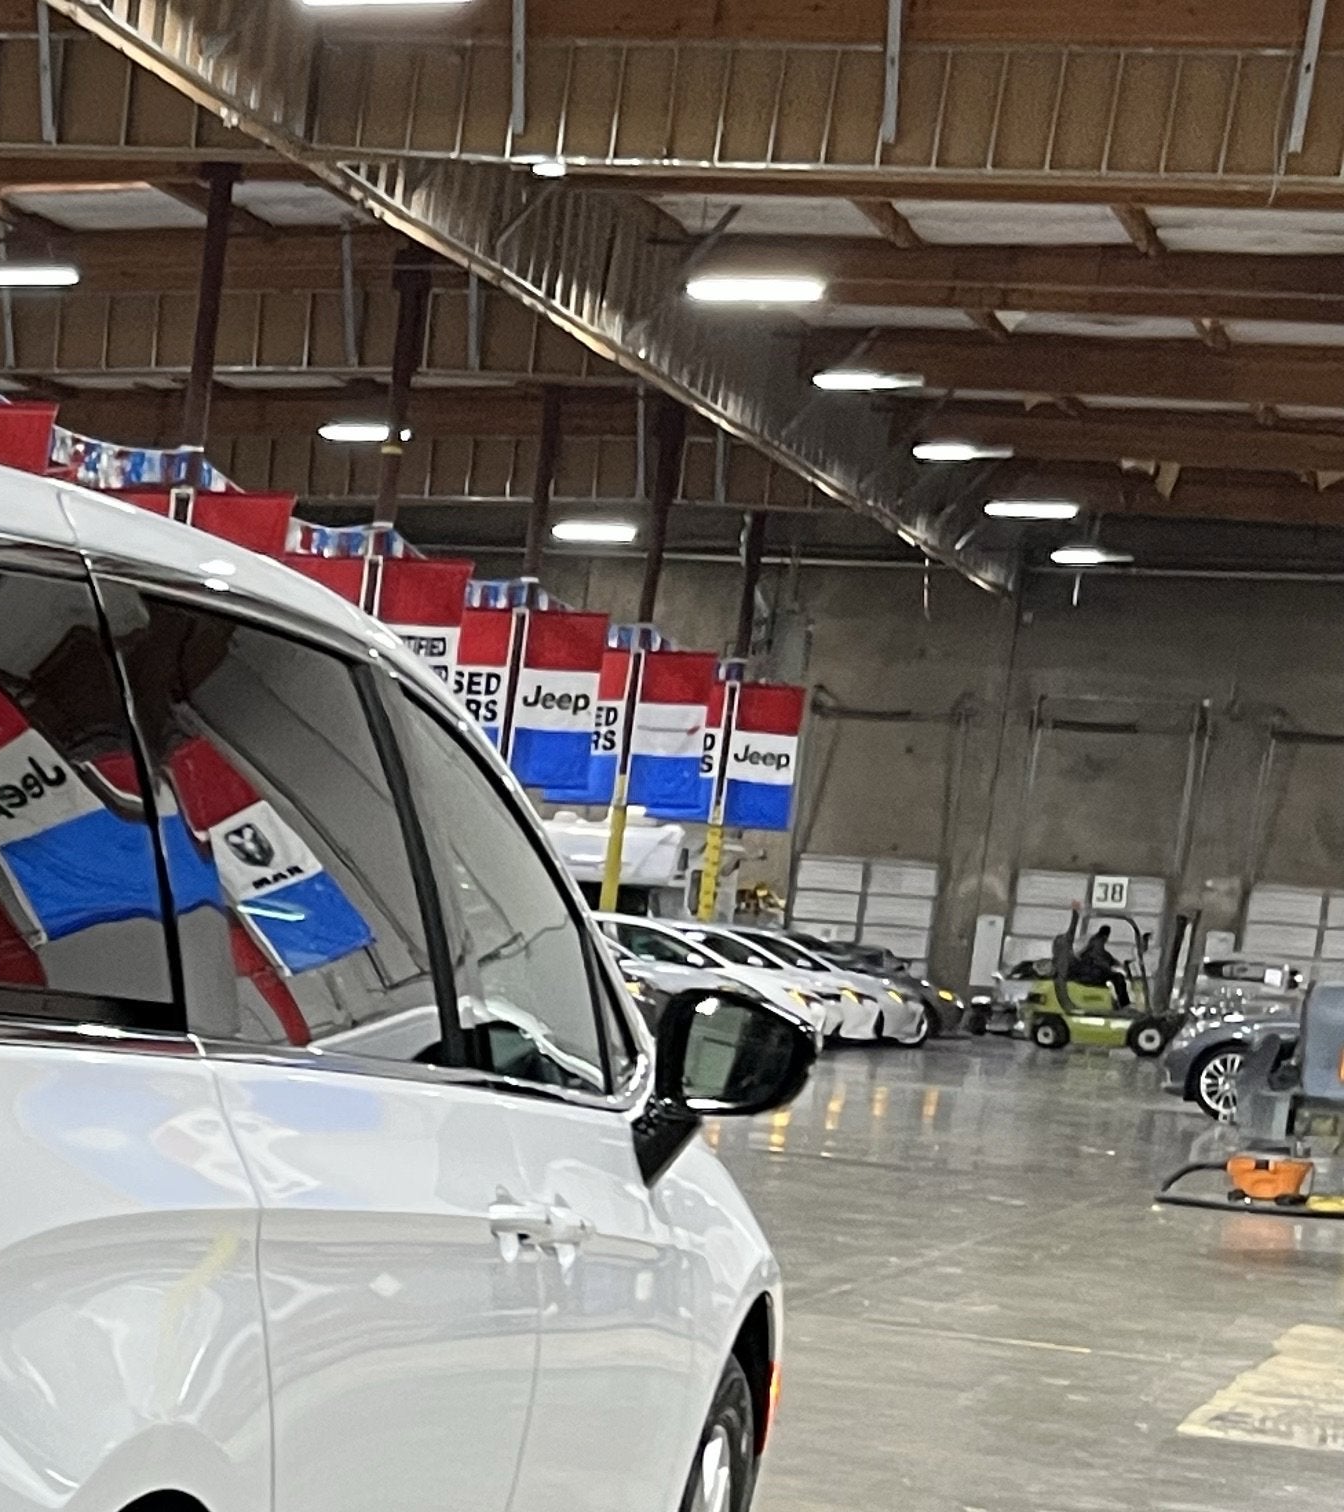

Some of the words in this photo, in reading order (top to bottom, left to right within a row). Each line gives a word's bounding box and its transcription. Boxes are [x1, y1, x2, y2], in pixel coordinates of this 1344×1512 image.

[453, 671, 502, 696] SED
[522, 685, 591, 715] Jeep
[734, 744, 790, 770] Jeep
